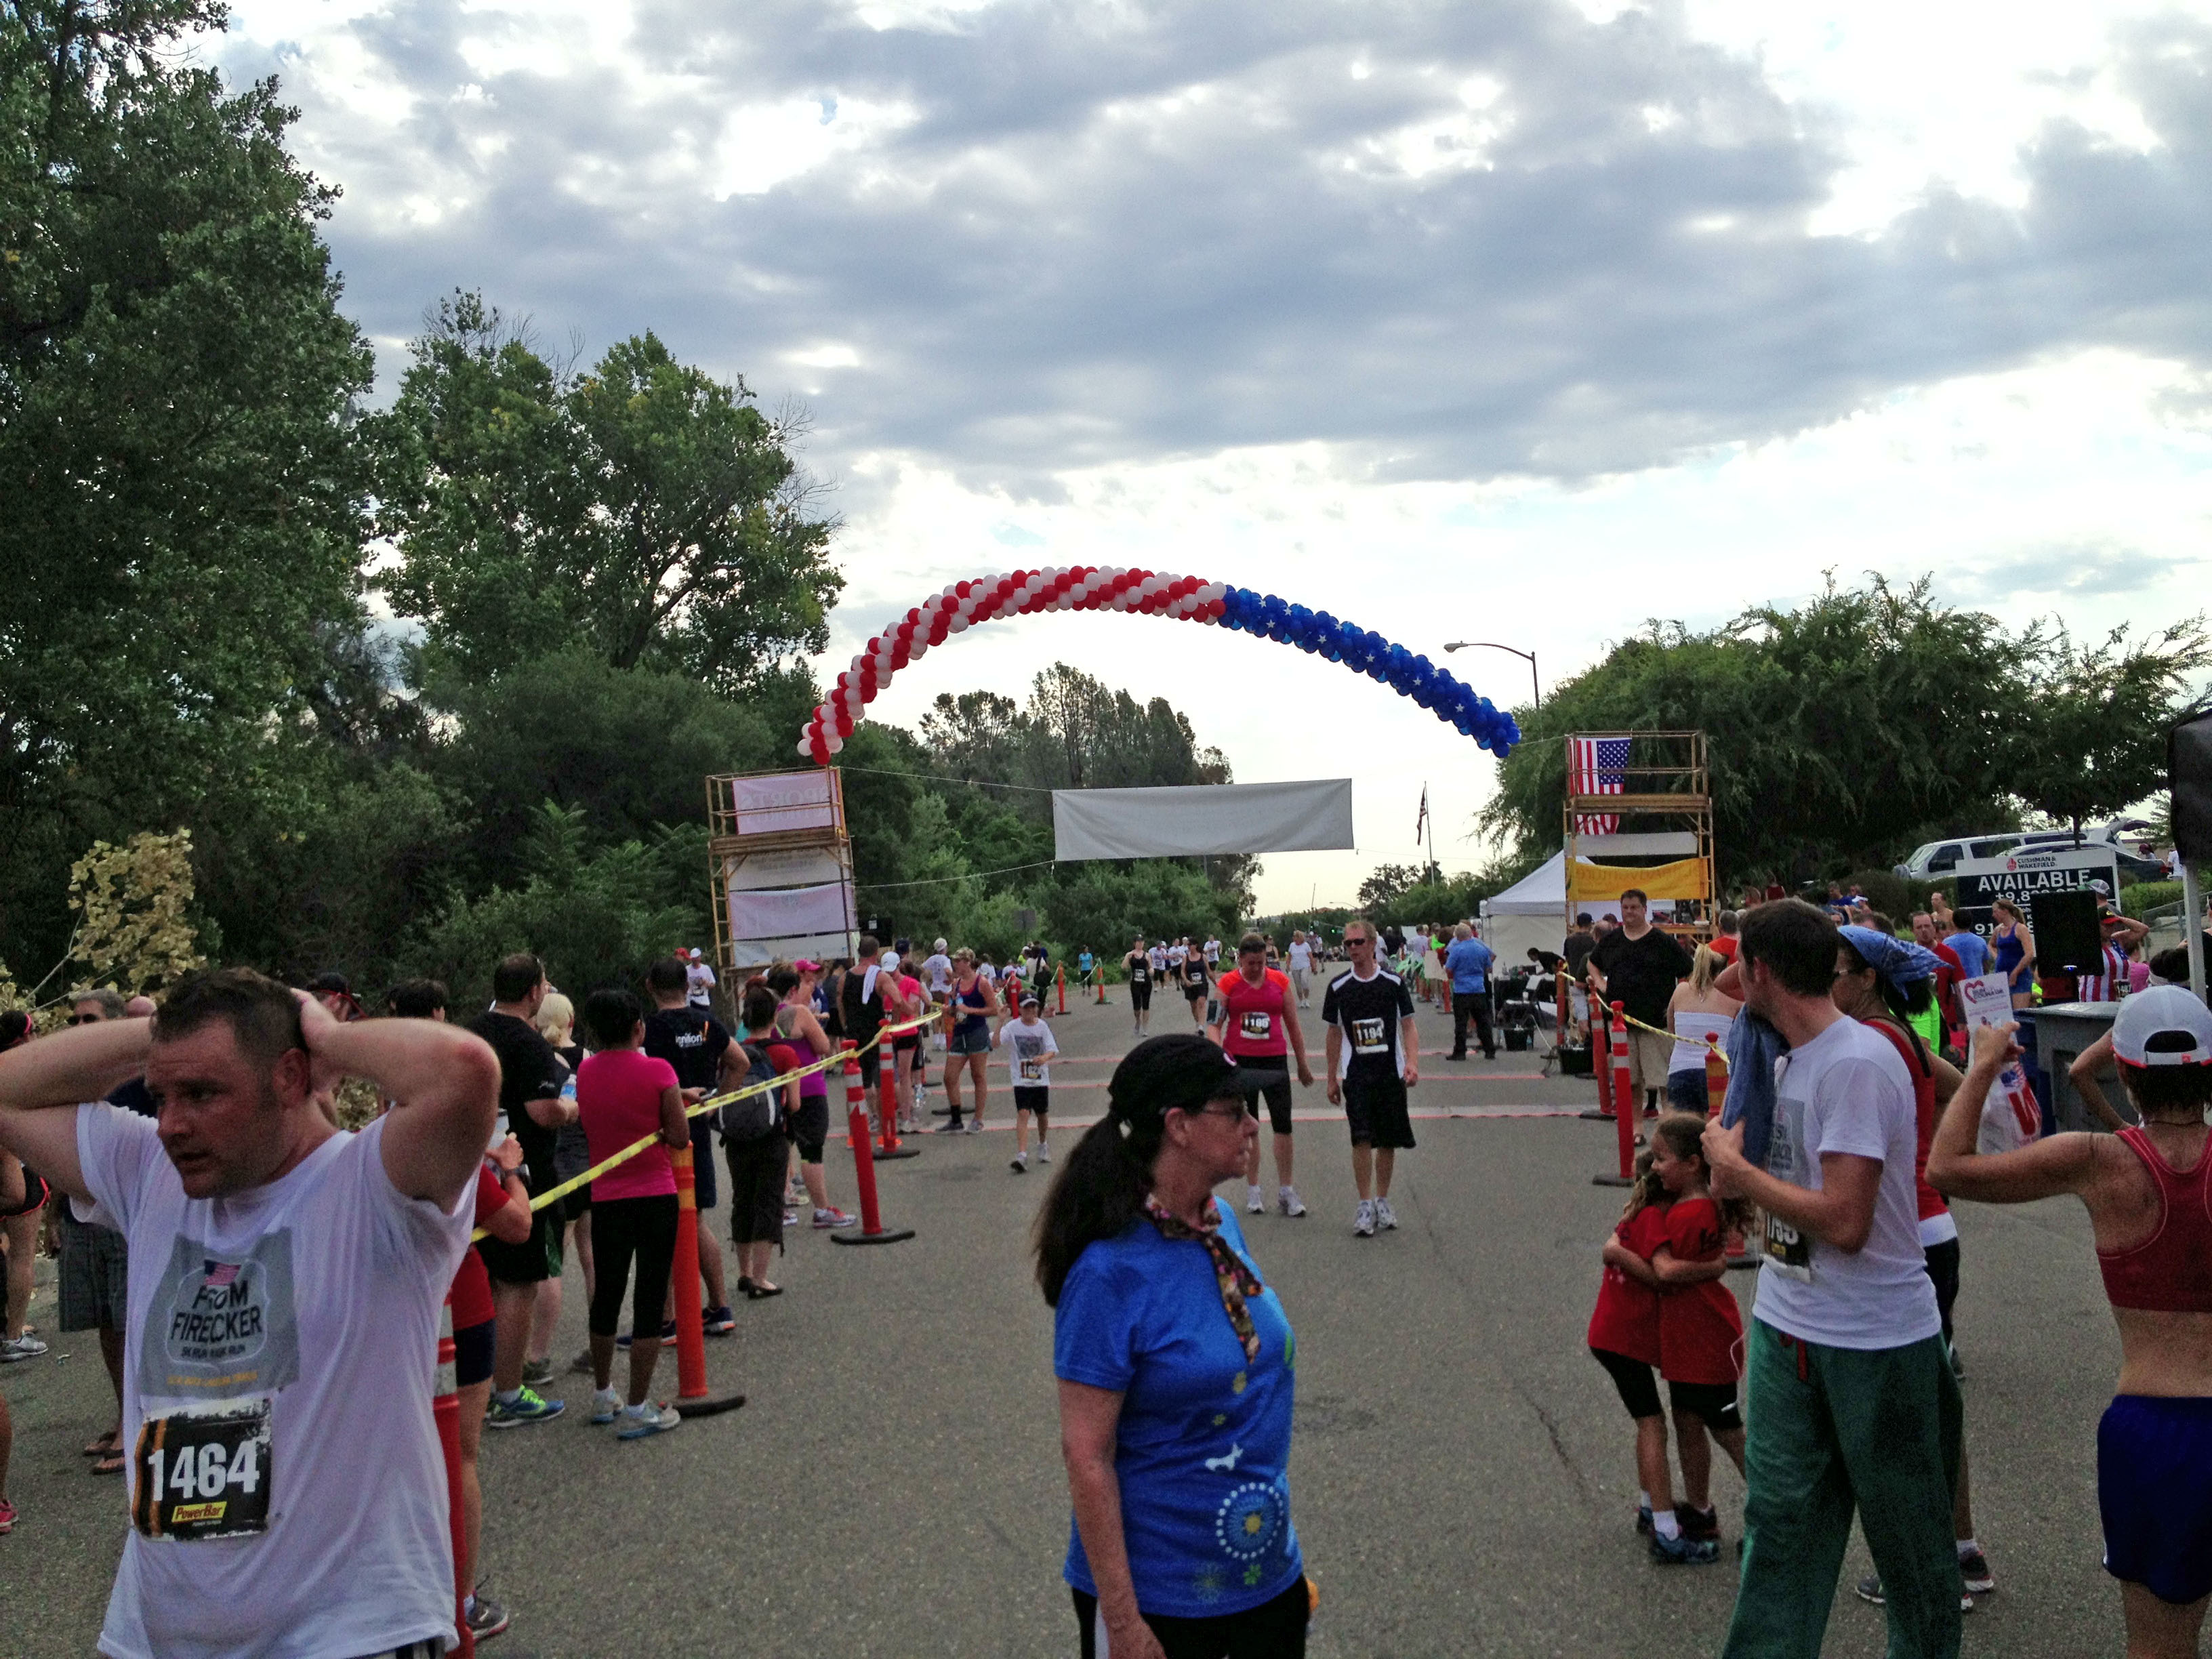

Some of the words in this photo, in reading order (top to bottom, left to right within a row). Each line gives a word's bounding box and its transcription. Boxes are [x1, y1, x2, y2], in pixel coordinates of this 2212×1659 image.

[1978, 869, 2091, 892] AVAILABLE
[148, 1439, 260, 1502] 1464
[176, 1503, 223, 1519] PowerBar
